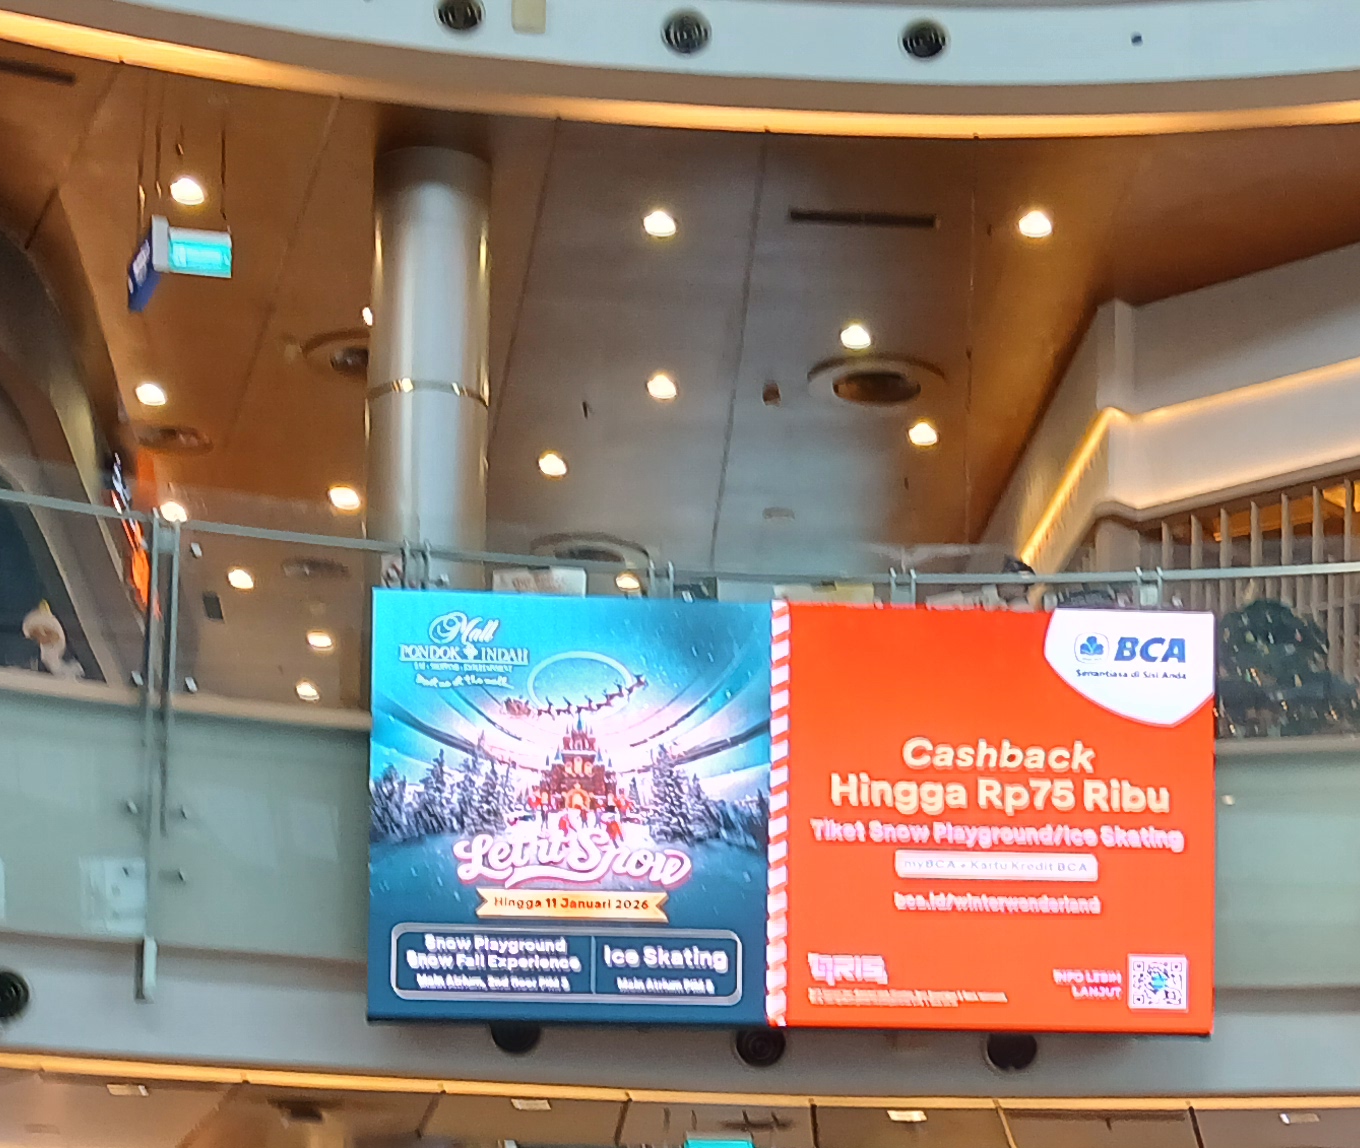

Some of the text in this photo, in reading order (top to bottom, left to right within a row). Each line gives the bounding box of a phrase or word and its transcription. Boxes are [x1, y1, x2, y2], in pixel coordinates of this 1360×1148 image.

[399, 644, 529, 664] PONDOK INDAH
[1114, 637, 1186, 663] BCA
[902, 736, 1095, 773] Cashback
[831, 772, 1170, 816] Hingga Rp75 Ribu
[810, 817, 1185, 853] Tiket Snow Playground/Ice Skating
[453, 832, 692, 889] Let it Snow
[1058, 862, 1087, 872] BCA
[494, 897, 649, 911] Hingga 11 Januari 2026
[424, 934, 567, 954] Snow Playground
[406, 950, 582, 972] Snow Fall Experience
[604, 944, 728, 973] Ice Skating
[808, 952, 888, 986] QRIS
